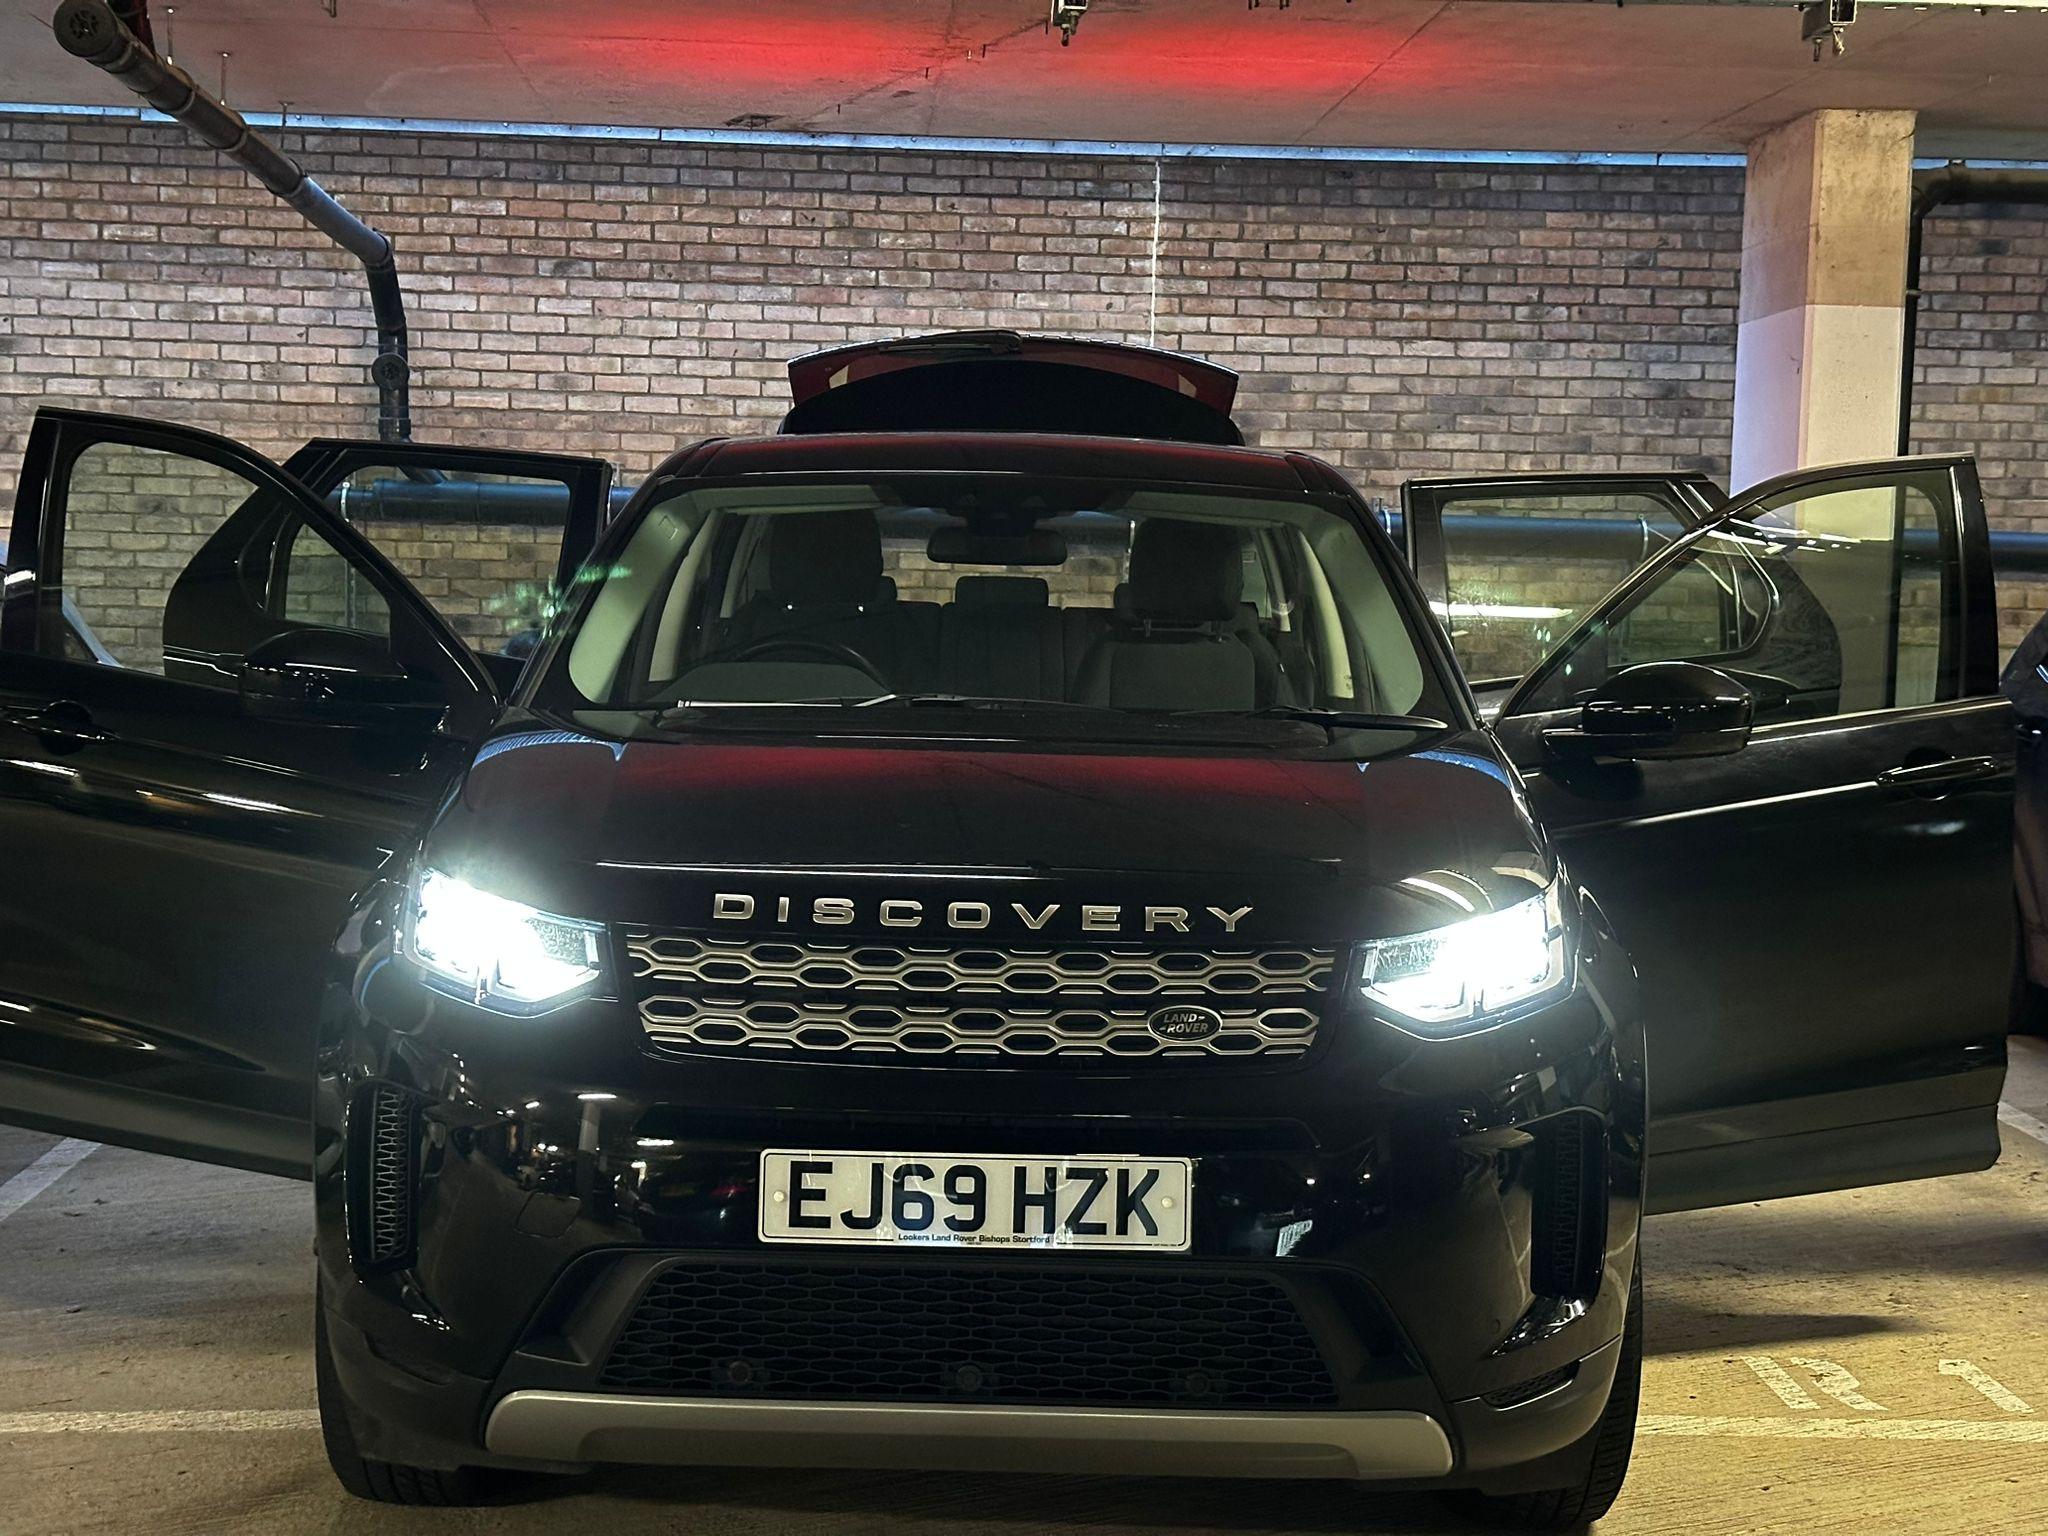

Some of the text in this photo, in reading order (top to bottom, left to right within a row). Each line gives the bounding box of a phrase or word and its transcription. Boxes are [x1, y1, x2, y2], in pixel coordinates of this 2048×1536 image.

[713, 893, 1253, 932] DISCOVERY
[788, 1160, 1160, 1237] EJ69 HZK
[898, 1233, 930, 1242] Lookers
[931, 1234, 951, 1242] Land
[953, 1234, 977, 1243] Rover
[978, 1235, 1011, 1244] Bishops
[1012, 1235, 1051, 1244] Stortford
